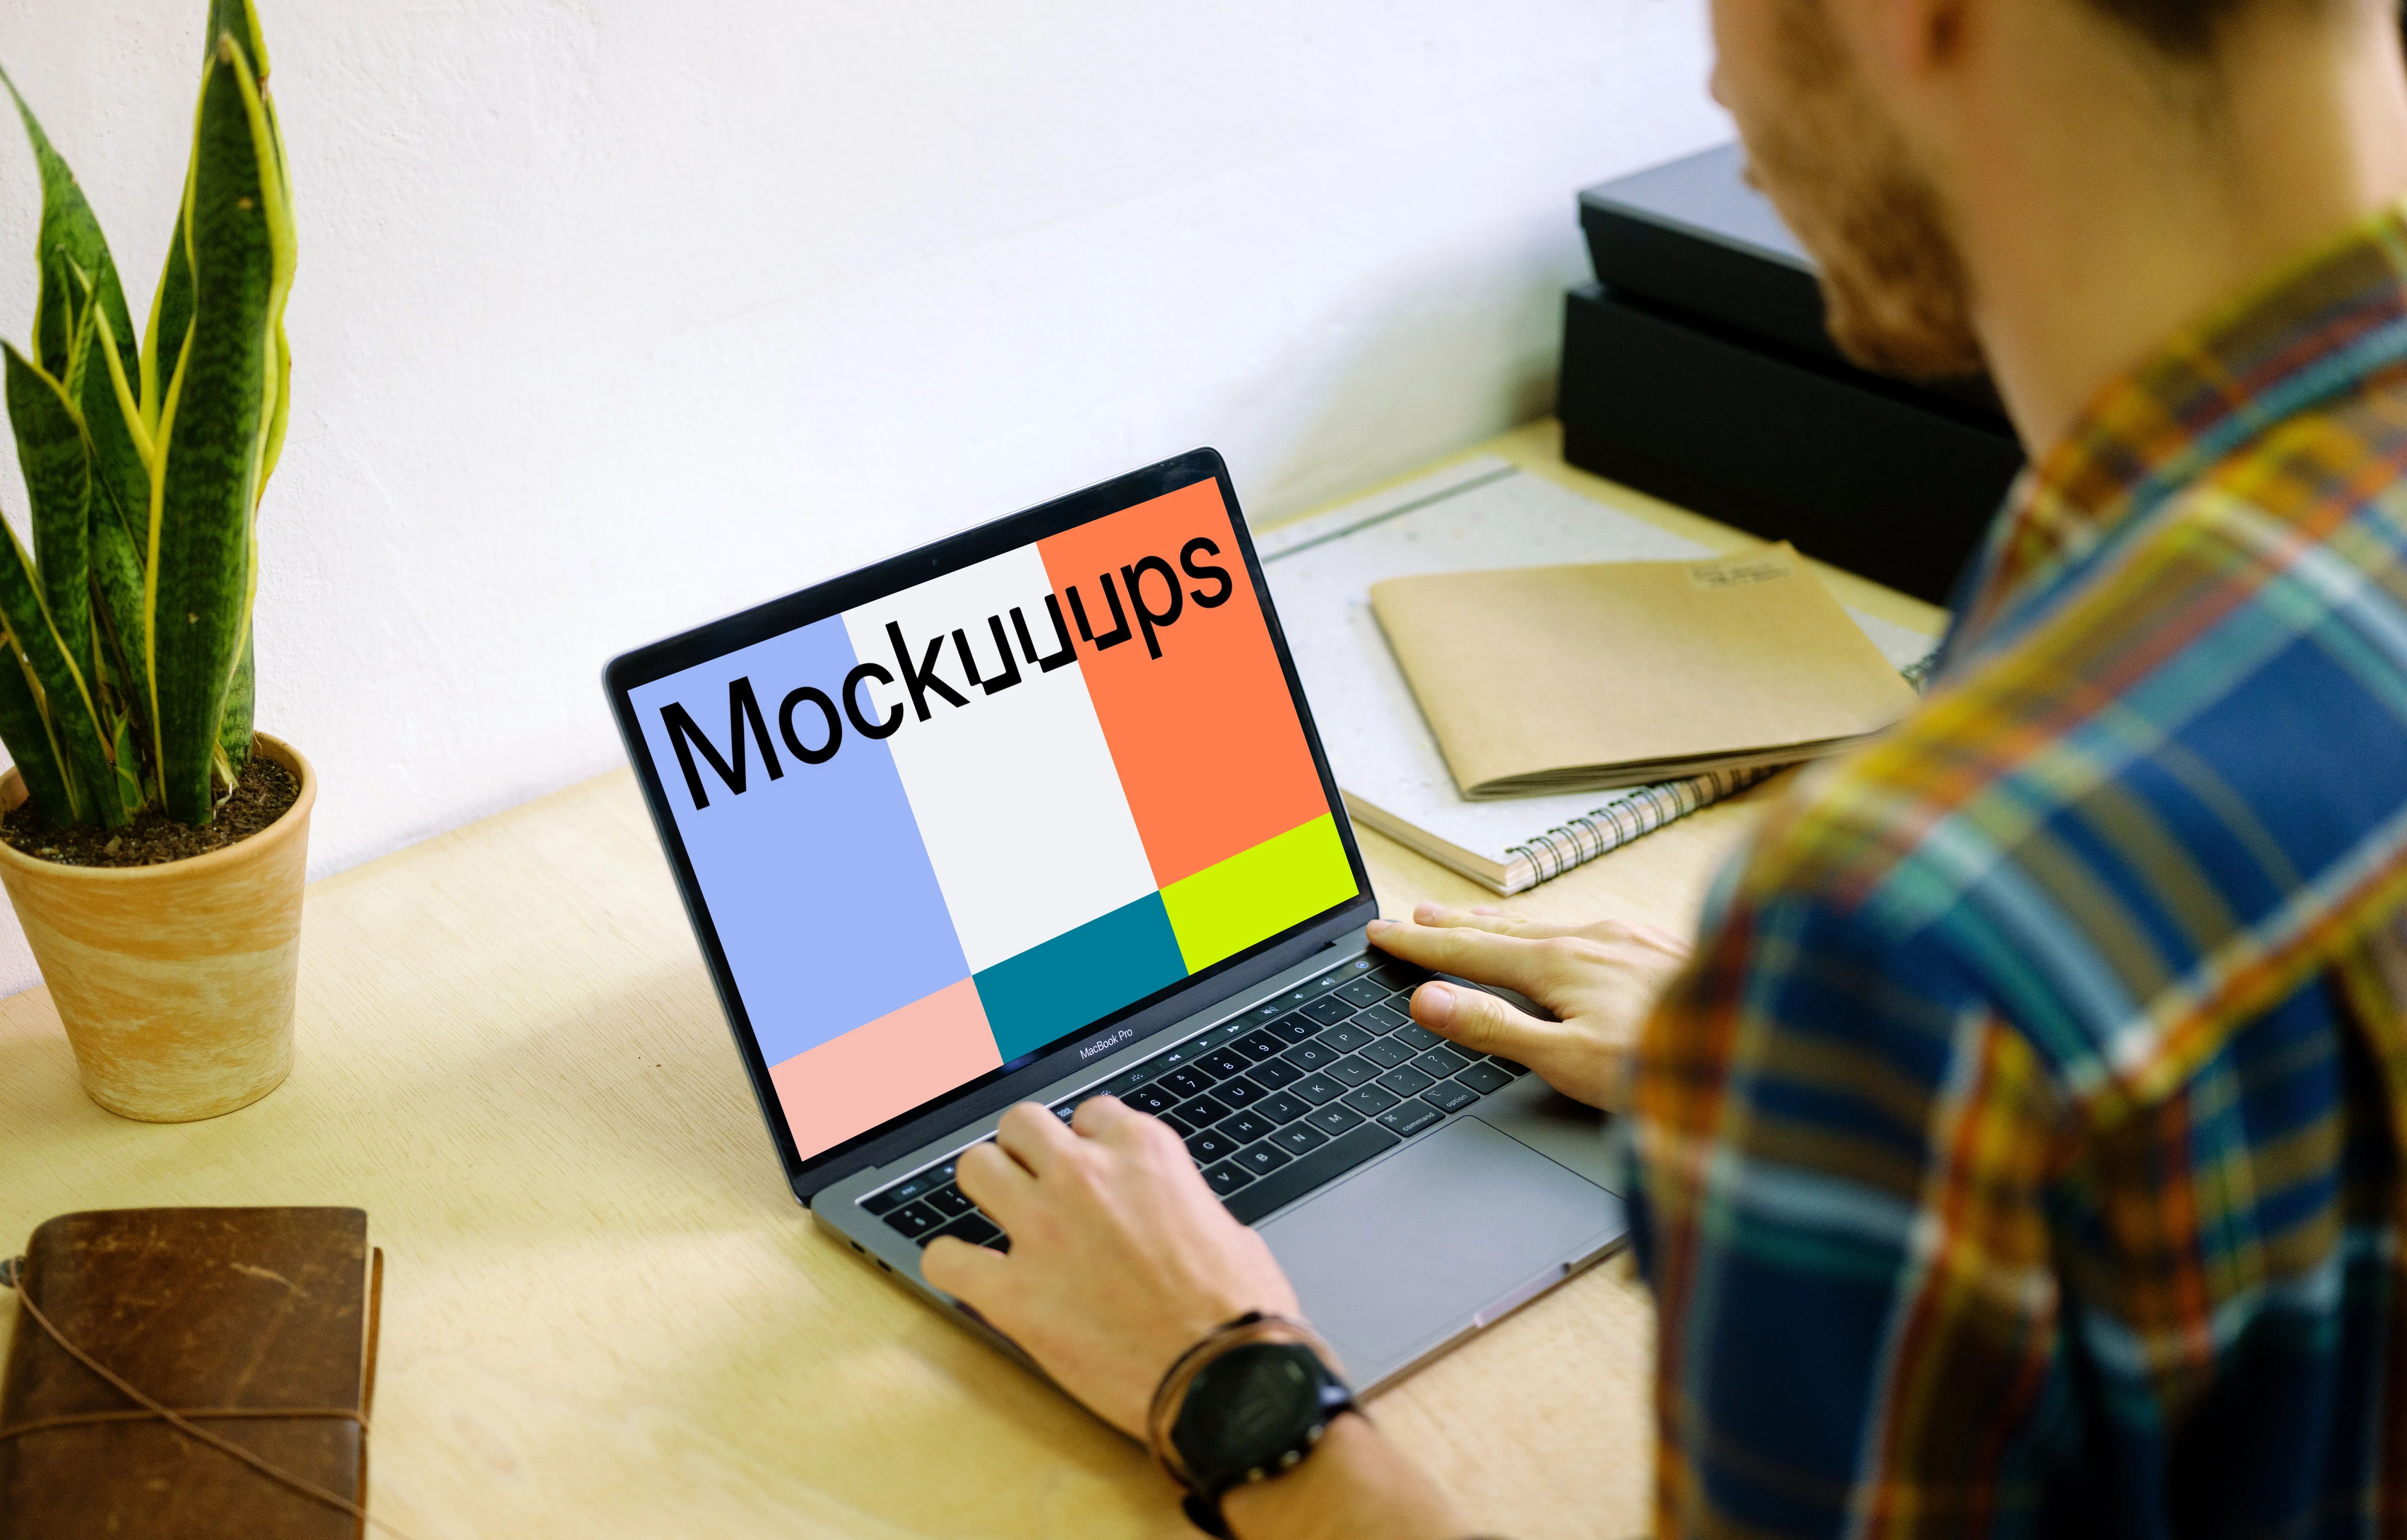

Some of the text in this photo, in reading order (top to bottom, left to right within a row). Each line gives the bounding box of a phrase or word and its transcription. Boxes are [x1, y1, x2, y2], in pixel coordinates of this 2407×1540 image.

[660, 537, 1232, 810] Mockuuups
[1079, 1029, 1133, 1059] MacBook Pro
[1446, 1094, 1468, 1107] option
[1328, 1114, 1342, 1123] M
[1402, 1111, 1435, 1132] command
[1239, 1122, 1252, 1130] H
[1293, 1133, 1306, 1142] N
[1203, 1142, 1215, 1150] G
[1255, 1154, 1268, 1162] B
[1217, 1172, 1229, 1181] V
